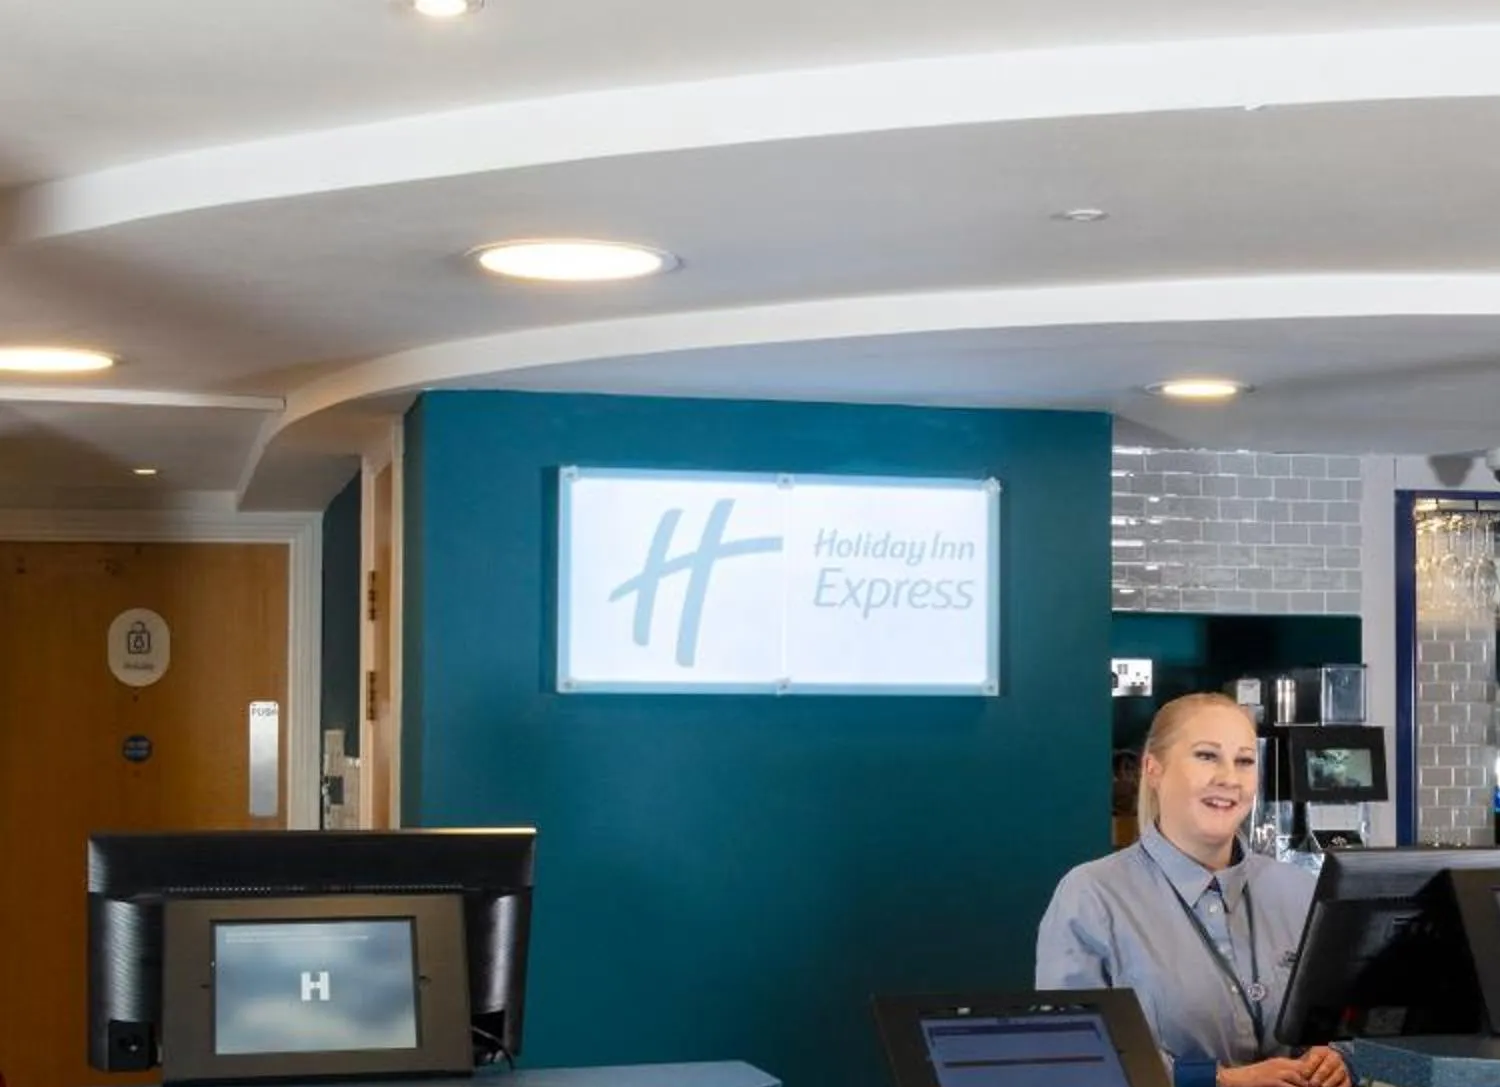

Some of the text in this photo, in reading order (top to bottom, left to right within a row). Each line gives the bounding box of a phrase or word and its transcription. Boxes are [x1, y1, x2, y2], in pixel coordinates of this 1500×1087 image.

[813, 527, 975, 566] Holiday Inn
[813, 566, 975, 619] Express
